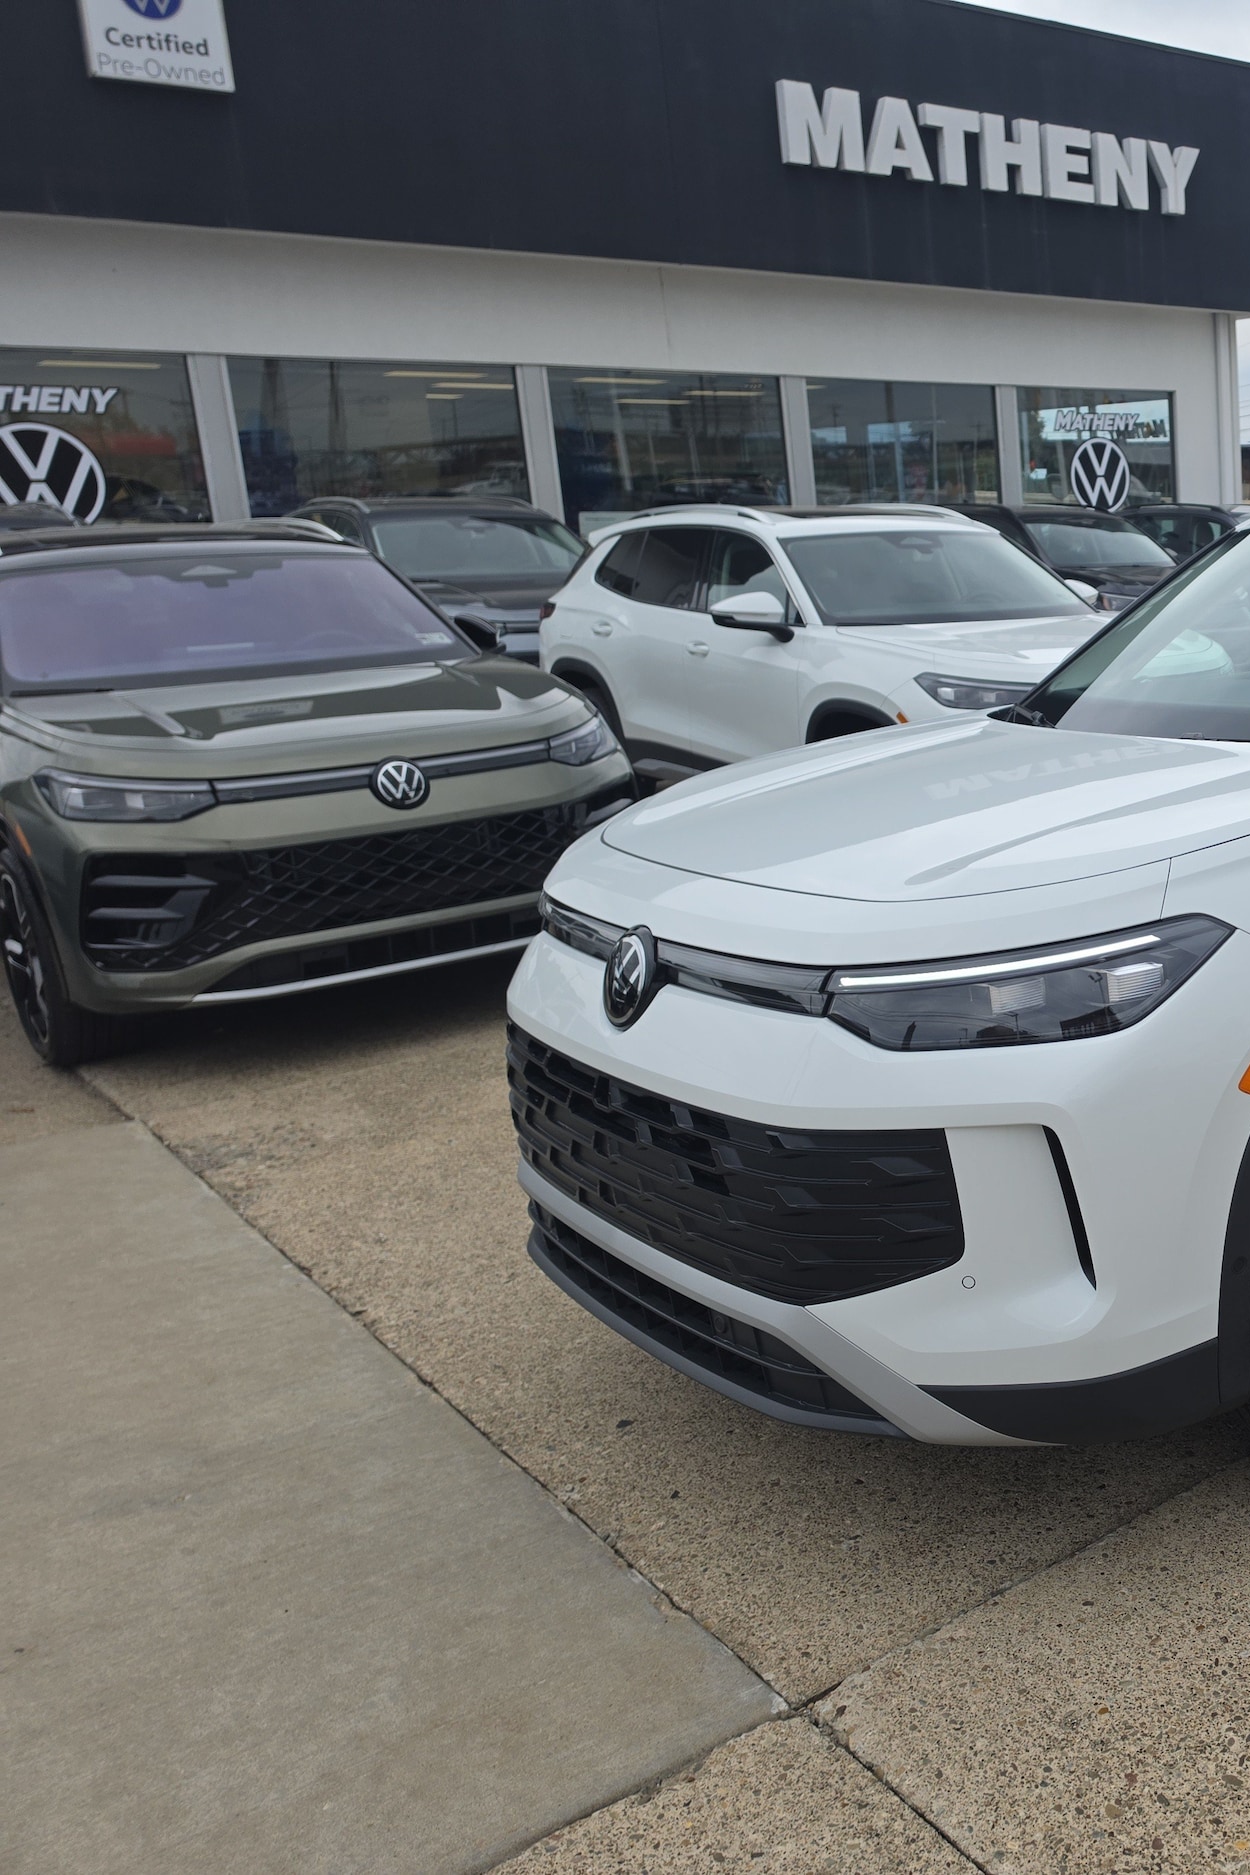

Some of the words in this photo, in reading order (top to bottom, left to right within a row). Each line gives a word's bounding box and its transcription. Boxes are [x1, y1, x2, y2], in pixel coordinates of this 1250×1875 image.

[105, 27, 209, 56] Certified
[97, 52, 226, 86] Pre-Owned
[775, 79, 1200, 216] MATHENY
[1054, 410, 1139, 432] MATHENY
